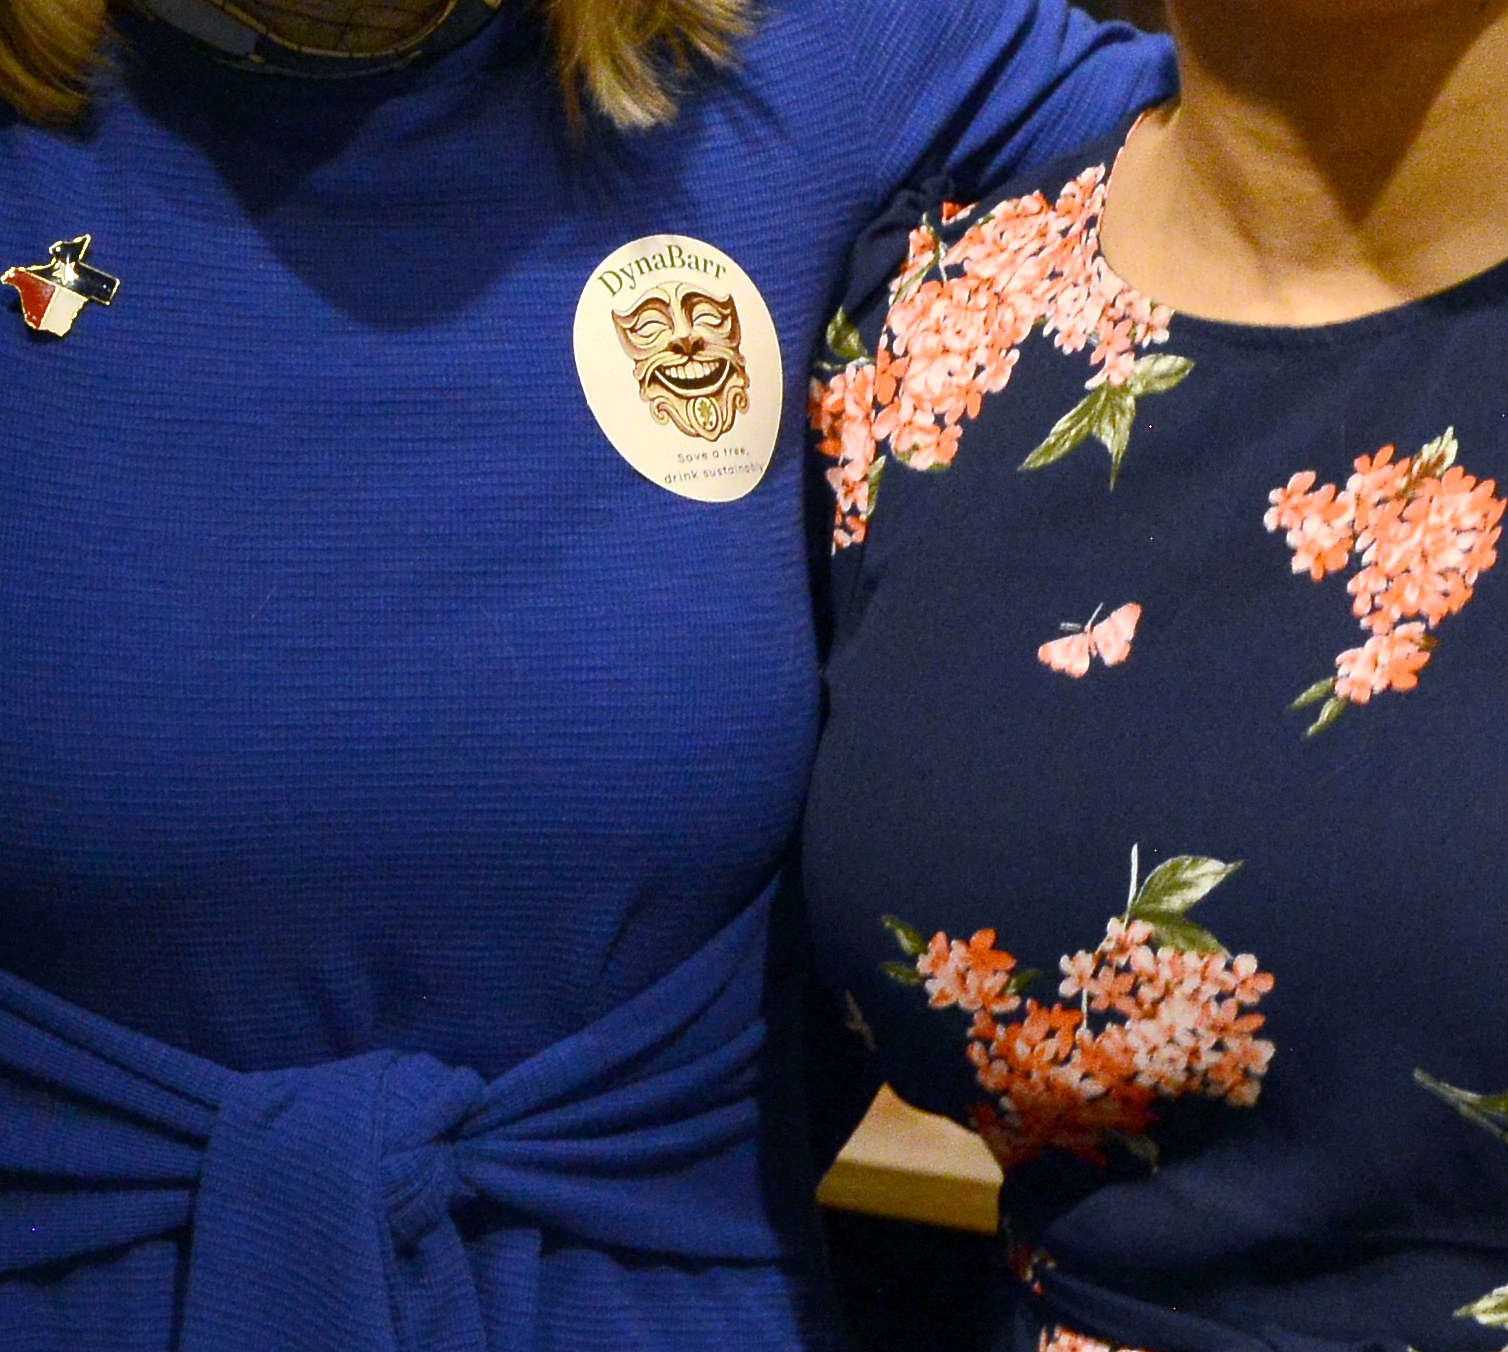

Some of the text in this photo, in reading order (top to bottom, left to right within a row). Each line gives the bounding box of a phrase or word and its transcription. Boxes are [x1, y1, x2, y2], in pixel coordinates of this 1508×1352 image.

[597, 244, 727, 297] DynaBarr
[677, 451, 708, 464] Save
[712, 450, 720, 458] a
[664, 469, 698, 484] drink
